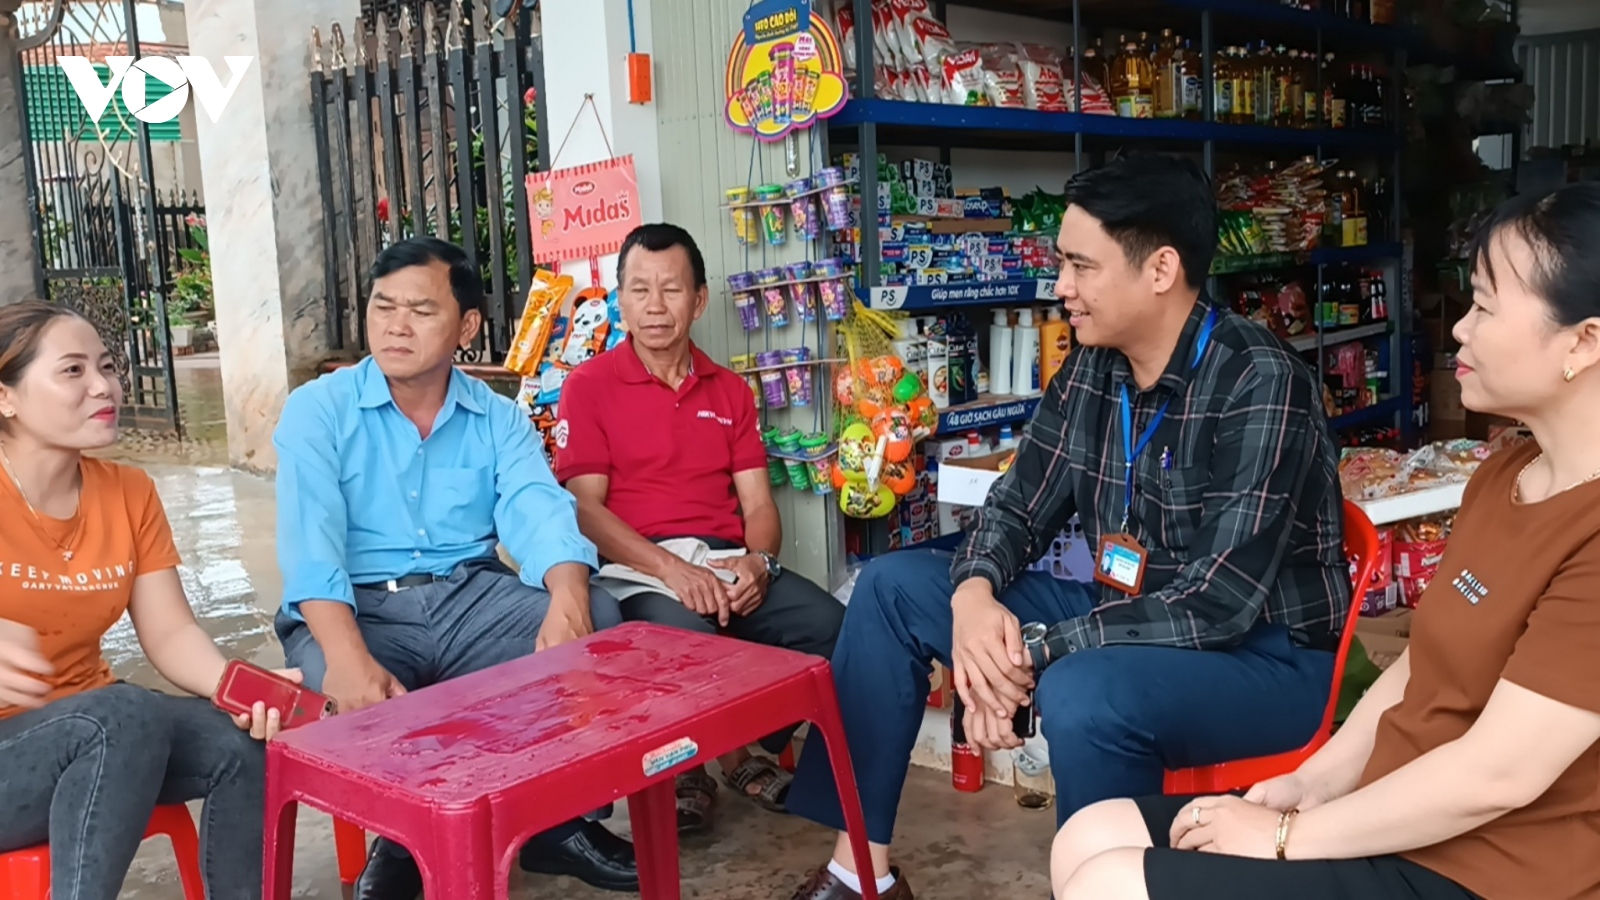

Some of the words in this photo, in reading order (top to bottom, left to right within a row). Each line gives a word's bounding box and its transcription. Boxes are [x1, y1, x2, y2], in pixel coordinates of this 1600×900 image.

[919, 161, 930, 174] PS
[922, 180, 932, 191] PS
[920, 199, 933, 210] PS
[970, 242, 980, 253] PS
[911, 250, 926, 263] PS
[984, 259, 995, 269] PS
[881, 289, 896, 302] PS
[948, 289, 963, 298] men
